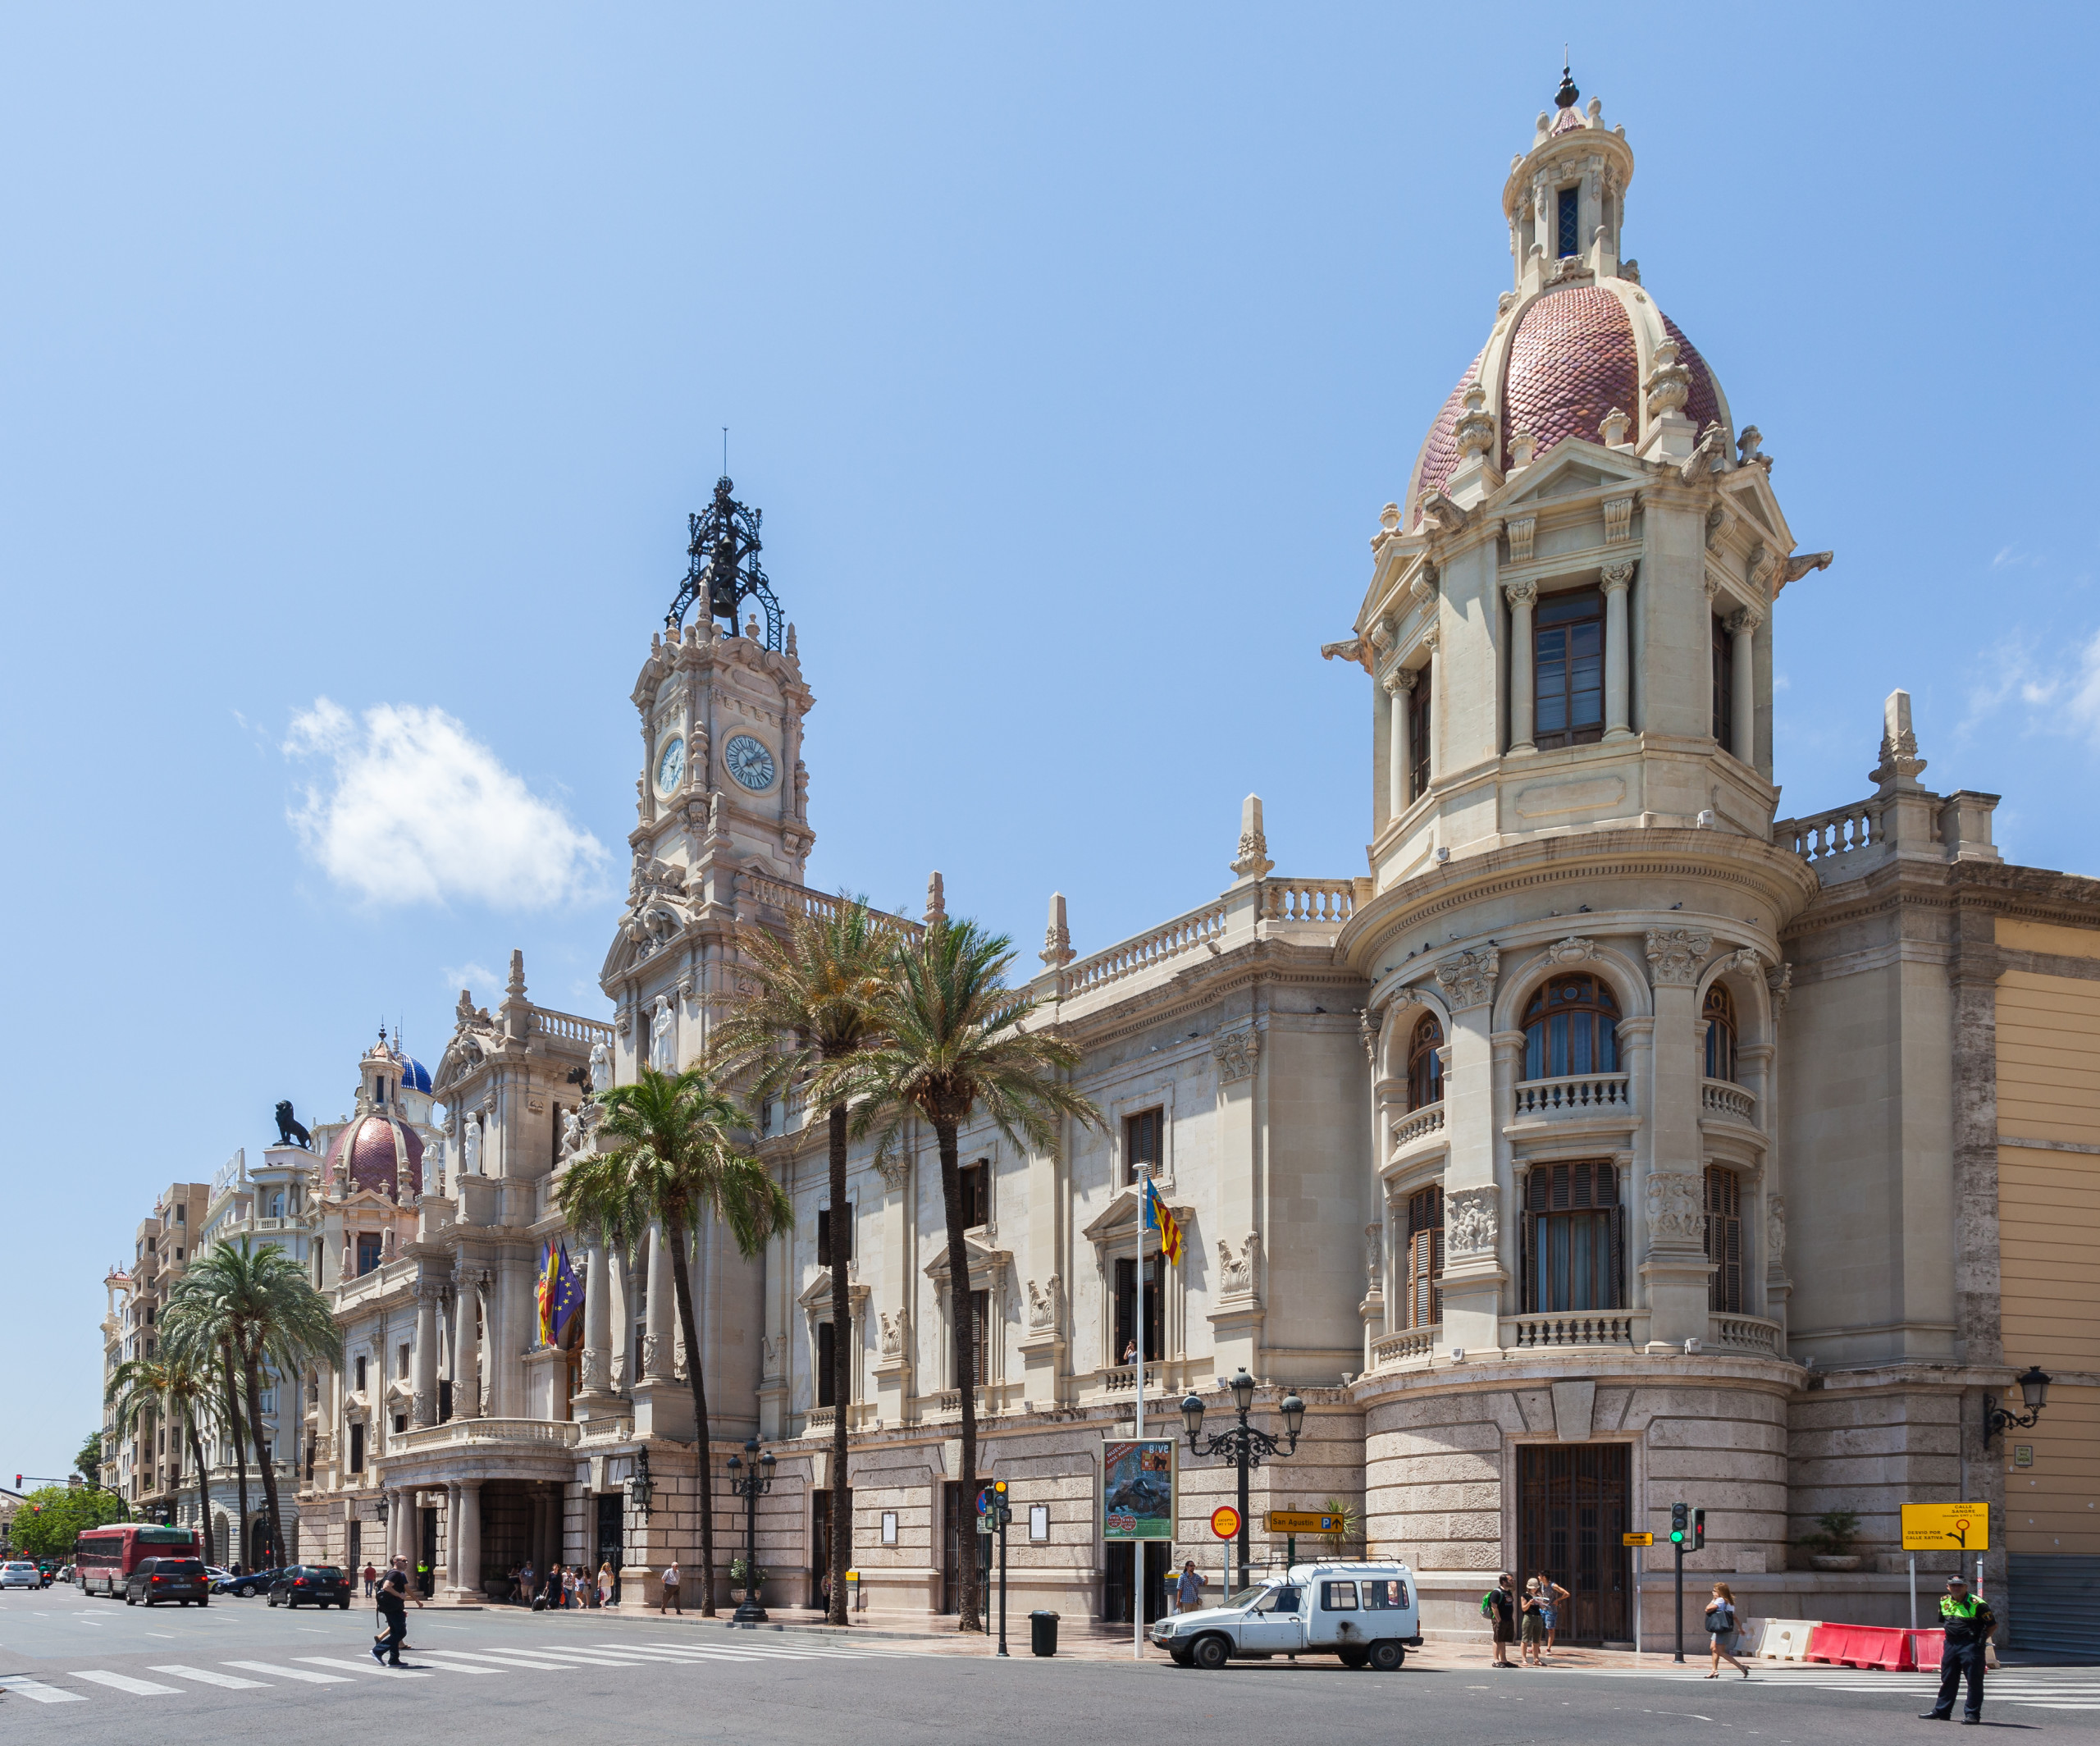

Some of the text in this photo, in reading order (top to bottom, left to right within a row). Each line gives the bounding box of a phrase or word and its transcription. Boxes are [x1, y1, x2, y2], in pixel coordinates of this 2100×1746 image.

[1107, 1443, 1125, 1457] NUEVO
[1107, 1446, 1133, 1465] PASE ANUAL
[1322, 1518, 1330, 1528] P
